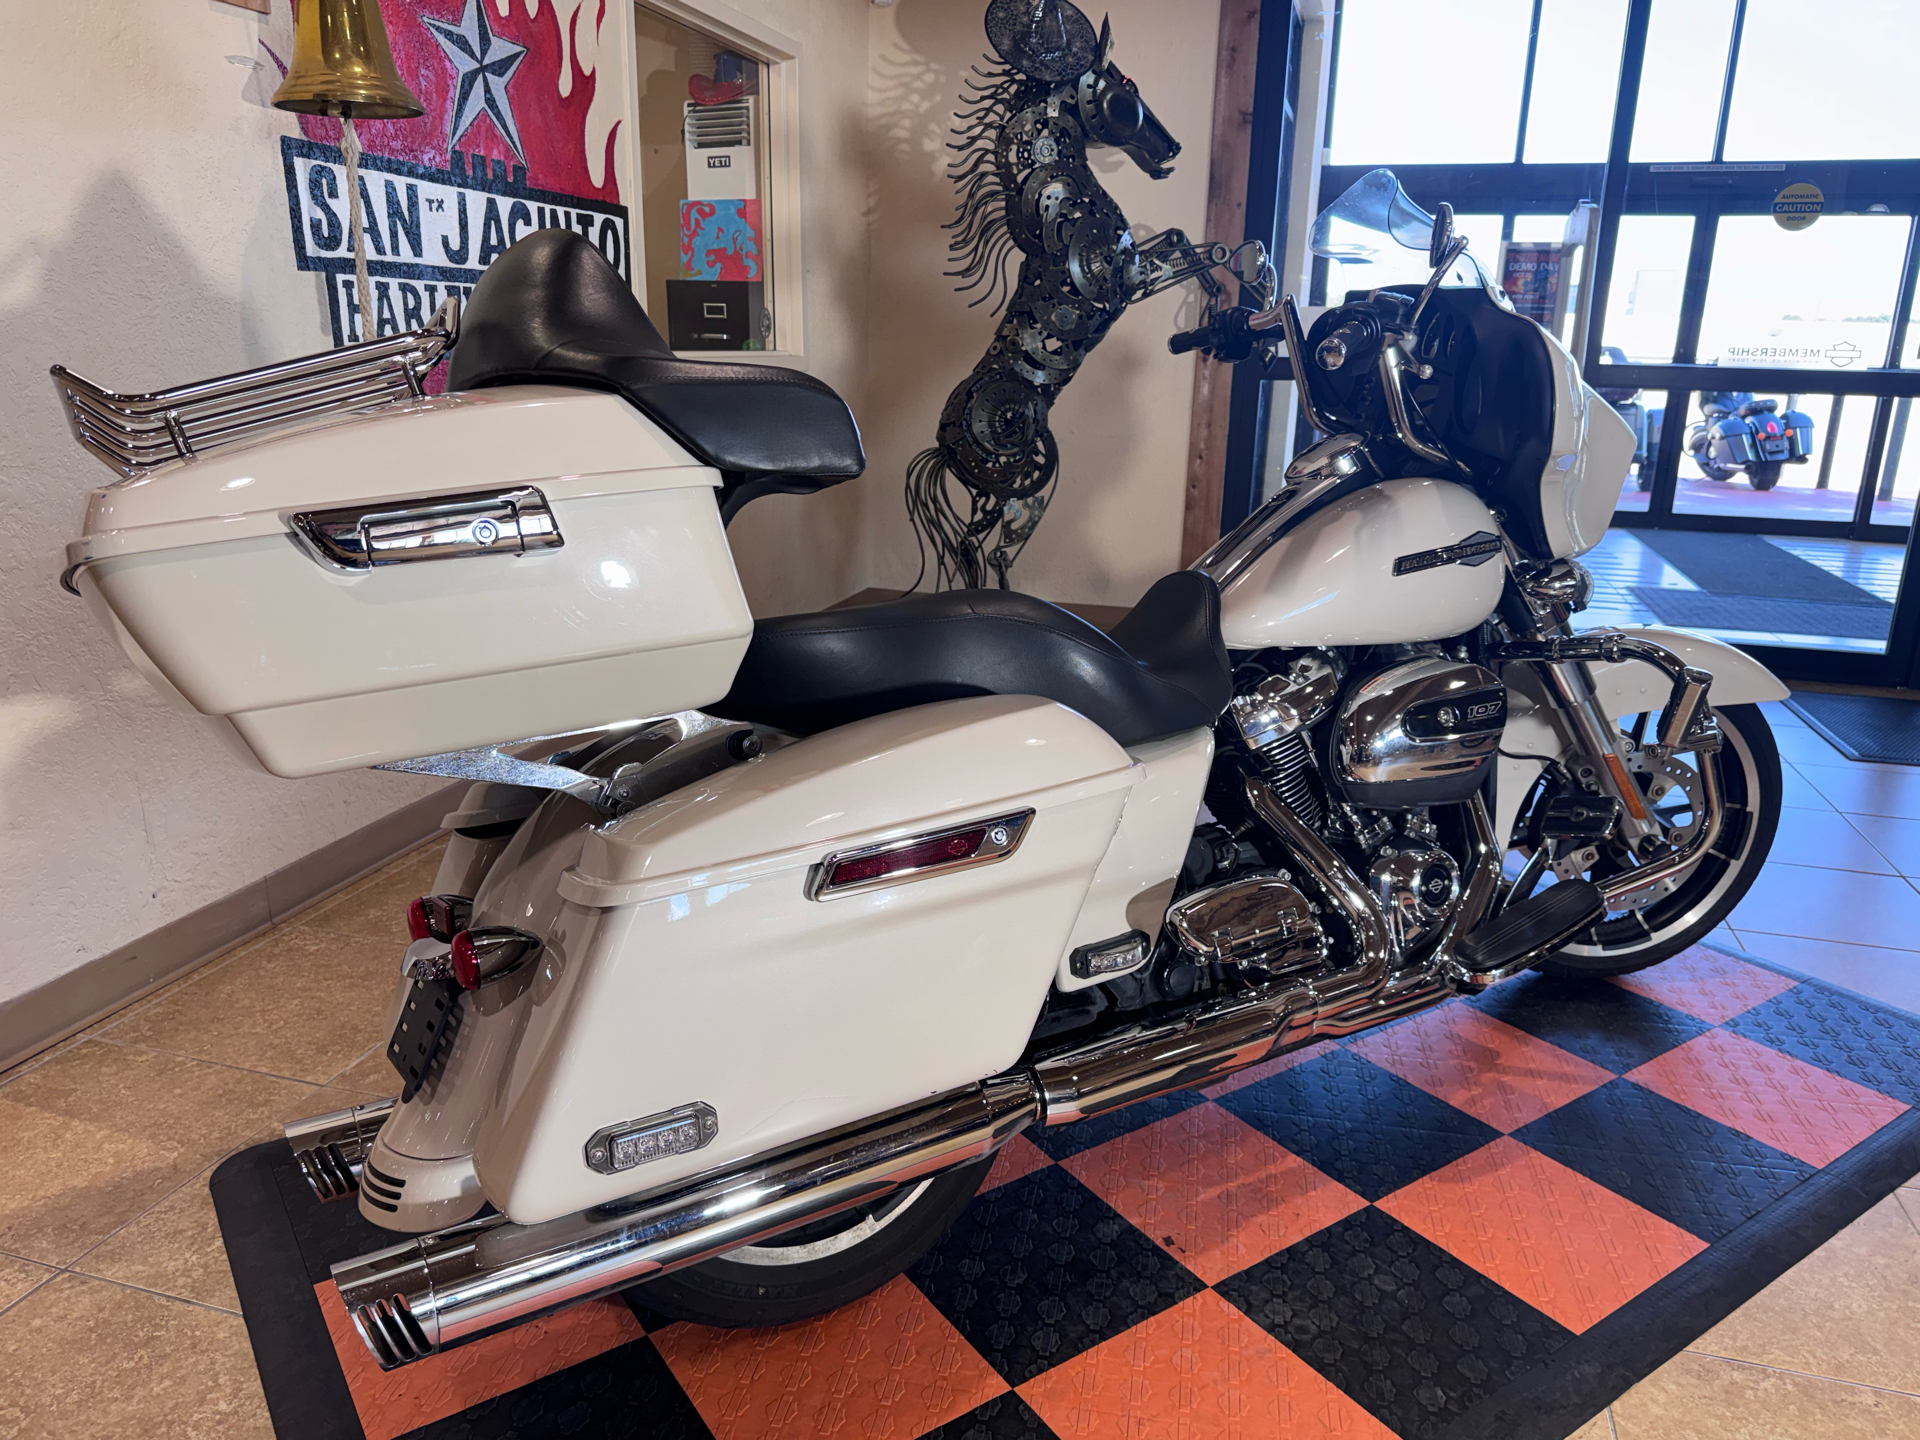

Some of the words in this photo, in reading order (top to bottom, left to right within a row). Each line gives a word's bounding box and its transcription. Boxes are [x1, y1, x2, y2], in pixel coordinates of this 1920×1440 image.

[708, 157, 730, 167] YETI
[308, 164, 423, 257] SAN
[425, 198, 445, 213] TX
[1775, 203, 1822, 212] CAUTION
[1509, 262, 1537, 271] DEMO
[1540, 262, 1560, 271] DAY
[1466, 700, 1502, 719] 107
